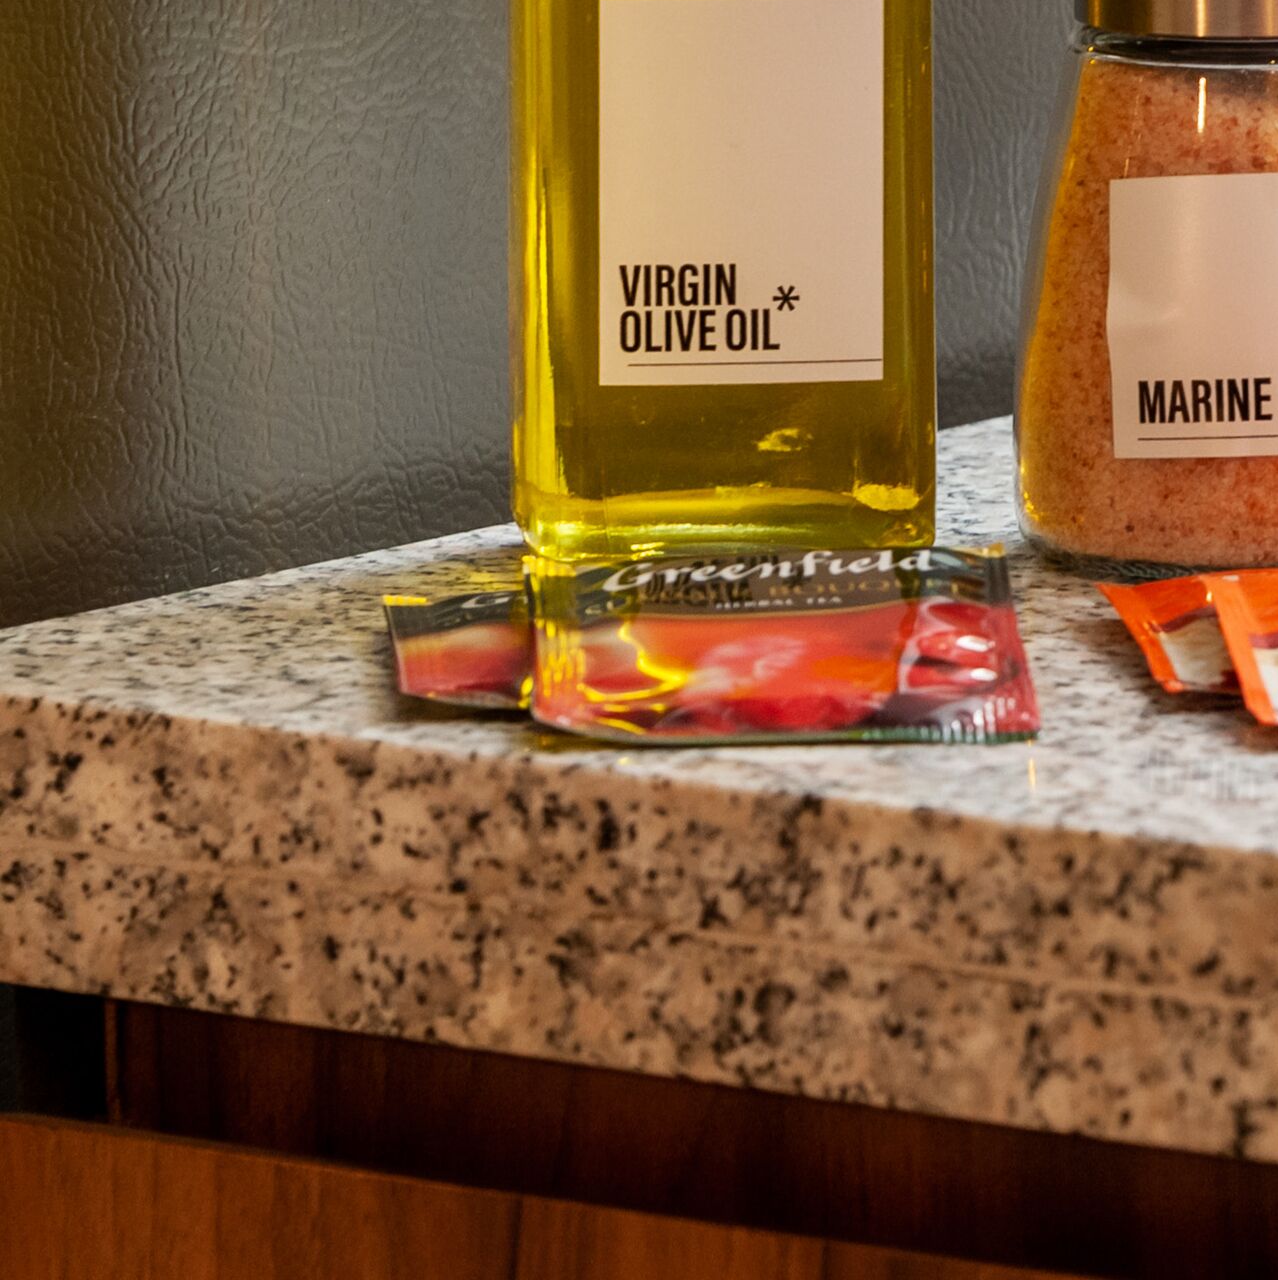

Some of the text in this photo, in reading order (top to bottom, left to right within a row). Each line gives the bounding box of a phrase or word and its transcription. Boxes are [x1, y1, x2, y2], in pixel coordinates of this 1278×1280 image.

[619, 263, 736, 307] VIRGIN
[619, 309, 717, 353] OLIVE
[1138, 378, 1273, 424] MARINE
[602, 548, 935, 592] Greenfield
